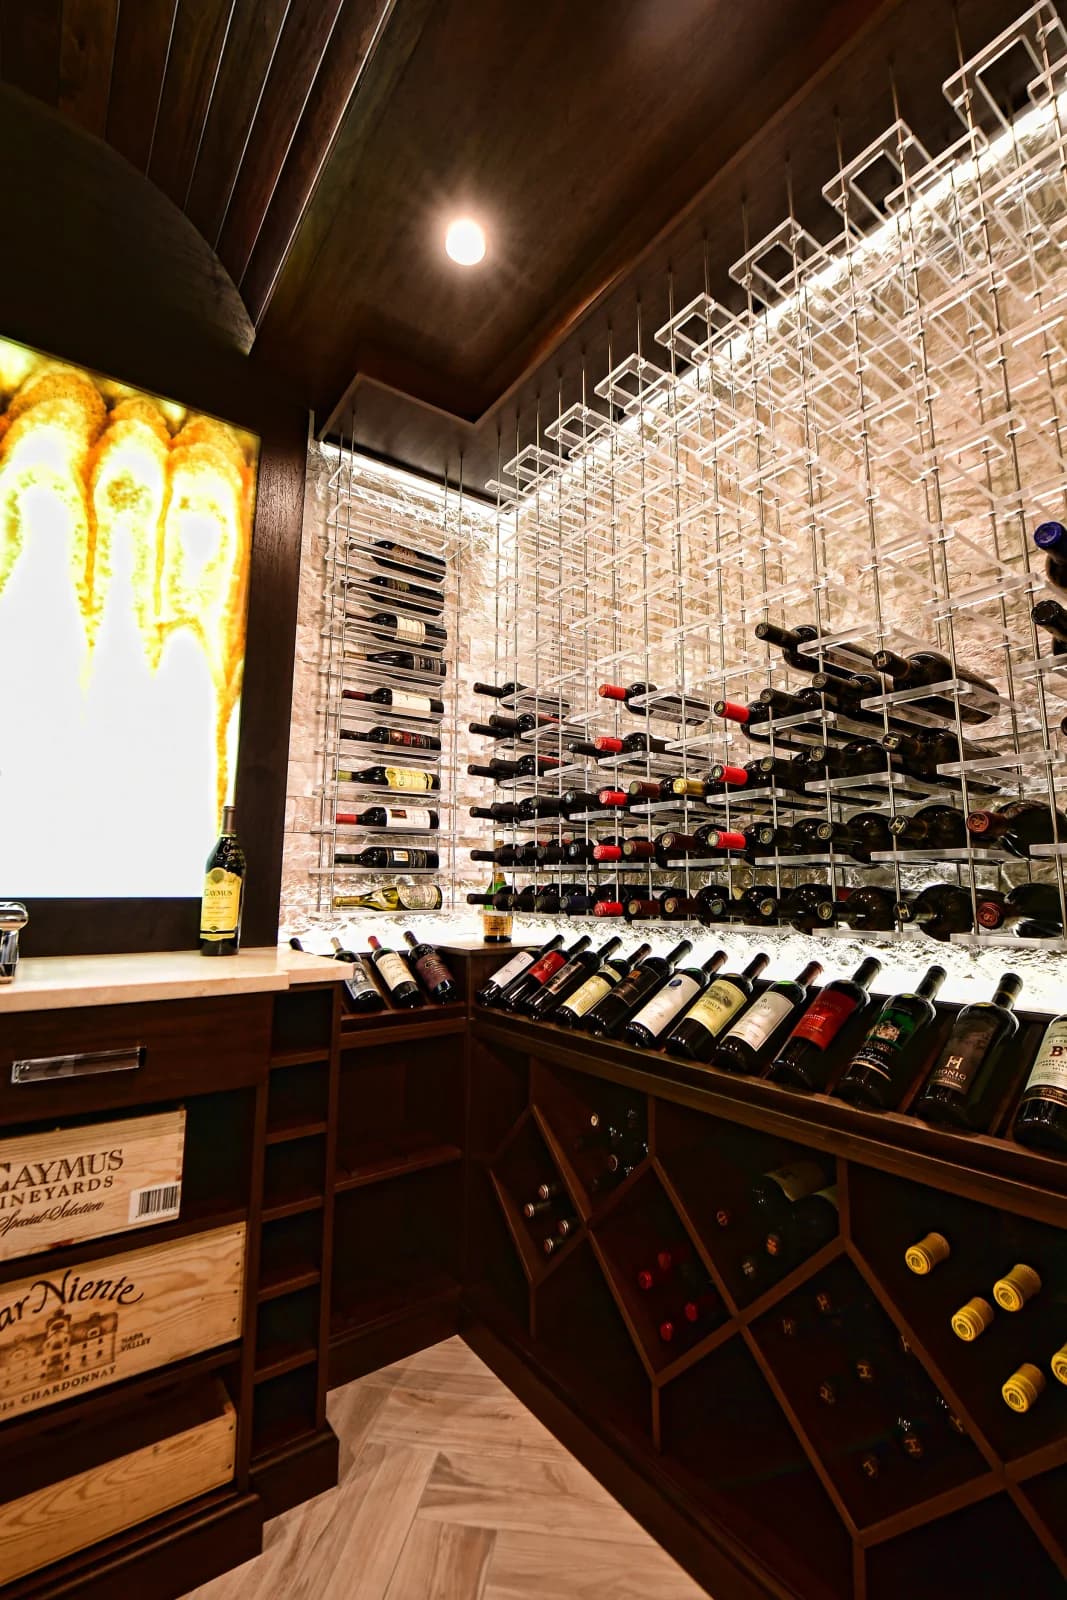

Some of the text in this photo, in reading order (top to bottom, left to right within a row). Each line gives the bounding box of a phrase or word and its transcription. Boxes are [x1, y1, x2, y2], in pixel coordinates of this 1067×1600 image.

[204, 888, 233, 897] CAYMUS
[1049, 1045, 1067, 1057] B
[0, 1175, 114, 1210] INEYARDS
[47, 1199, 105, 1221] Selection
[0, 1269, 145, 1332] ar Niente
[120, 1337, 152, 1352] VALLEY
[21, 1365, 117, 1404] CHARDONNAY
